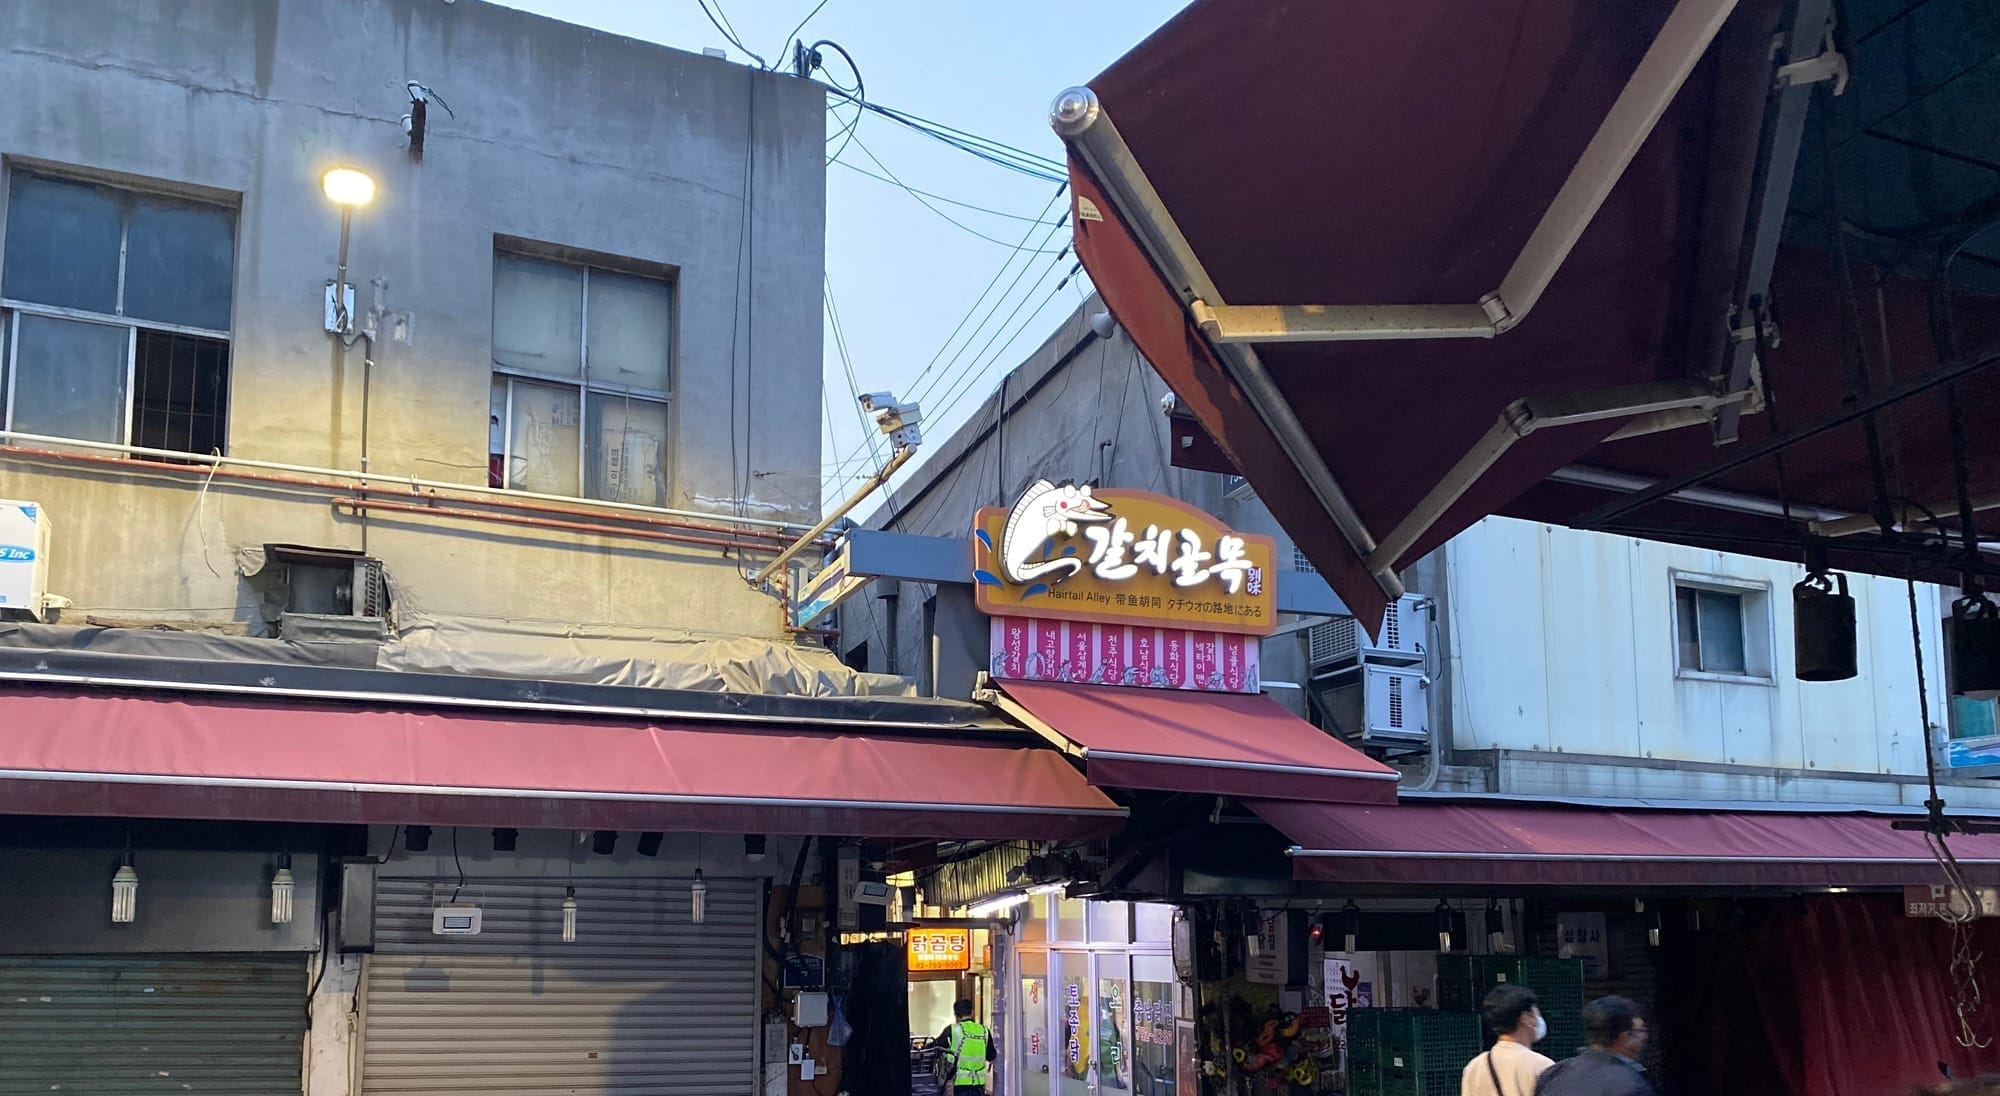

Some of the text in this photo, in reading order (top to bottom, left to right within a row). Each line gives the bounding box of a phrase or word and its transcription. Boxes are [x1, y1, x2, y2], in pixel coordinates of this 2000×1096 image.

[8, 549, 30, 559] Inc
[1084, 517, 1253, 594] 갈치골목
[1048, 588, 1085, 602] Hairtail
[1086, 591, 1111, 606] Alley
[1167, 599, 1262, 618] タチウオの路地にある
[1011, 628, 1022, 674] 왕성갈치
[1077, 632, 1088, 679] 서울삼계탕
[1108, 635, 1118, 681] 전주식당
[1140, 637, 1149, 683] 호남식당
[1206, 642, 1216, 664] 갈치
[911, 934, 967, 952] 닭곰탕
[1068, 984, 1080, 1062] 토종닭
[1134, 998, 1173, 1025] 충남닭집
